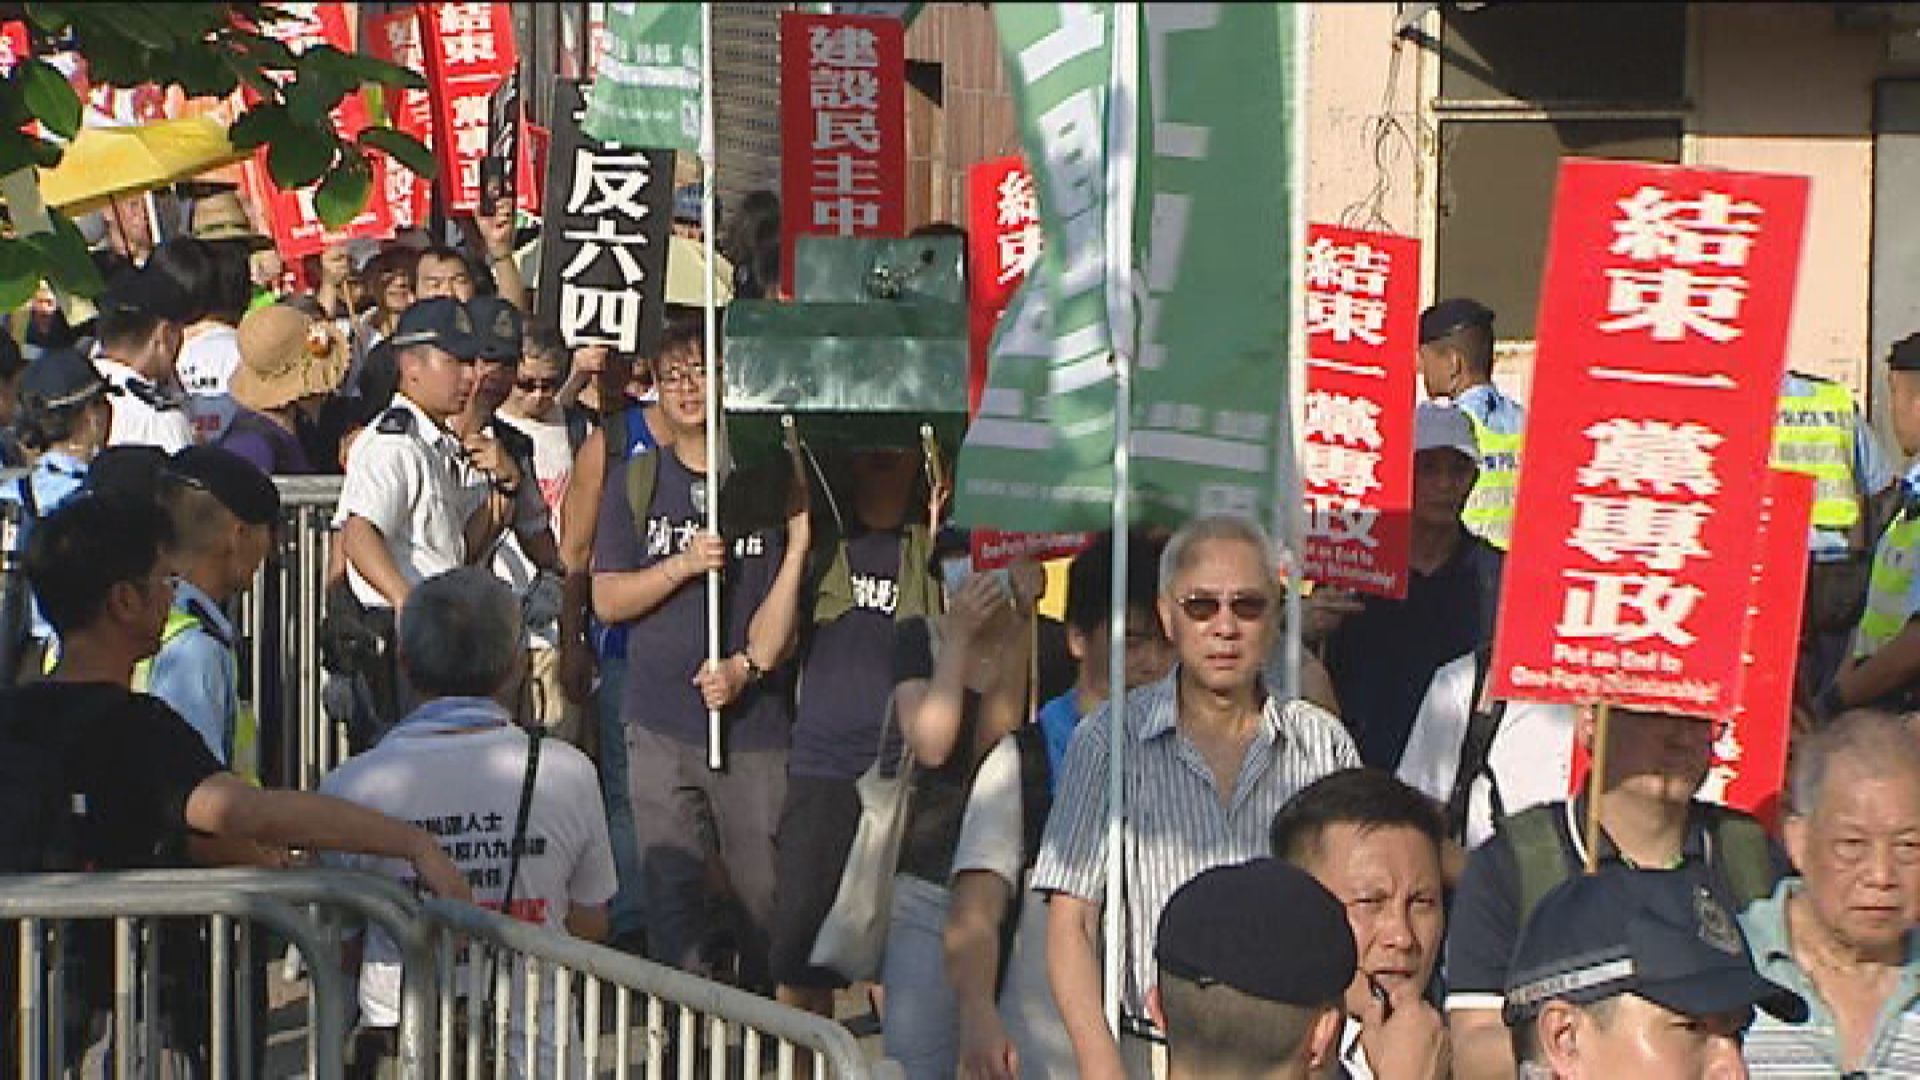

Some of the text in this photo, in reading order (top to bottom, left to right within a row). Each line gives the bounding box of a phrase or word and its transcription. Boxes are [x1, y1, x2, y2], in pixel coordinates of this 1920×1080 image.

[560, 83, 650, 352] 反六四
[808, 25, 881, 236] 建設民主中
[1304, 236, 1391, 548] 結束一黨專政
[1554, 185, 1766, 646] 結束一黨專政
